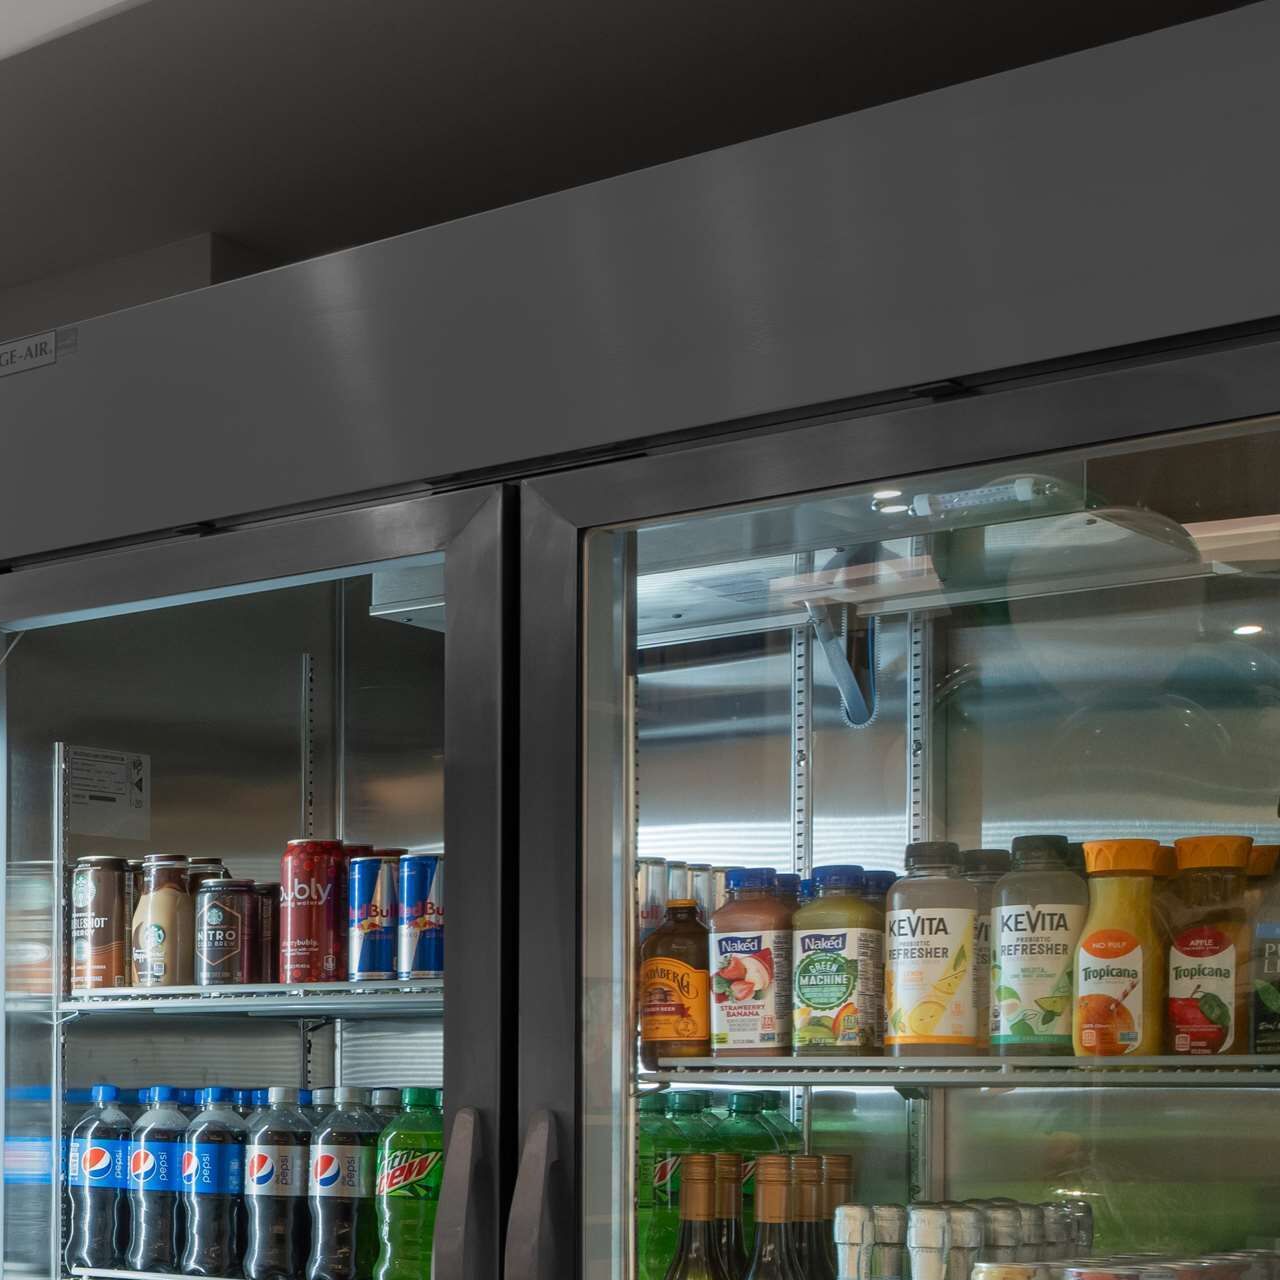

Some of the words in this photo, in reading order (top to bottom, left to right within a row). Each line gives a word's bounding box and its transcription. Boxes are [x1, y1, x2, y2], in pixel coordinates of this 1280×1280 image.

[1000, 910, 1070, 933] KEVITA
[721, 936, 760, 951] Naked
[804, 934, 846, 951] Naked
[1000, 943, 1070, 957] REFRESHER
[1189, 937, 1214, 947] APPLE
[808, 961, 839, 974] GREEN
[1082, 965, 1139, 981] Tropicana
[1172, 964, 1231, 981] Tropicana
[799, 973, 849, 987] MACHINE
[726, 1010, 760, 1018] BANANA
[115, 1149, 123, 1180] pepsi
[158, 1151, 169, 1182] pepsi
[202, 1152, 212, 1185] pepsi
[279, 1154, 290, 1187] pepsi
[347, 1154, 357, 1186] pepsi
